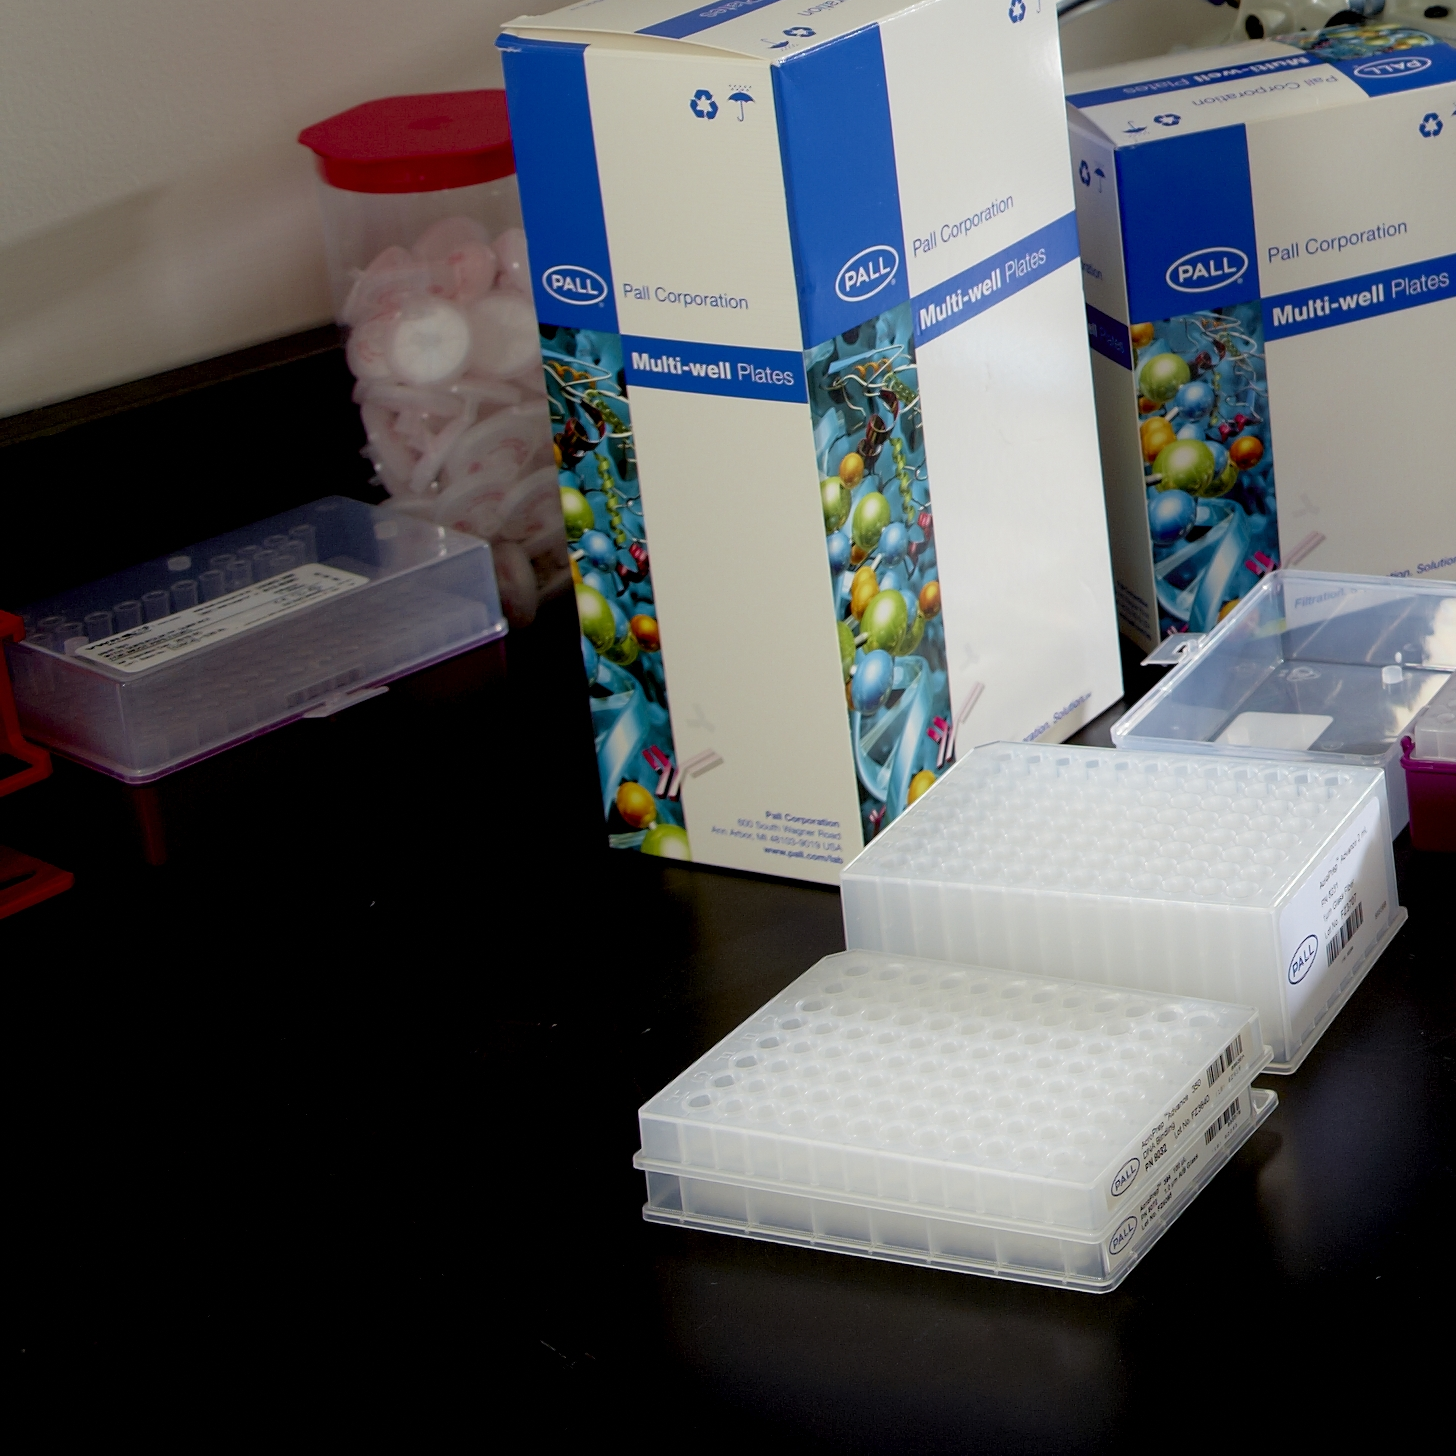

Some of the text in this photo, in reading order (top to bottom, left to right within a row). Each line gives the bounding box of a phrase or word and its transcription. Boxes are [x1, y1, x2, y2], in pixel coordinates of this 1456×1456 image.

[1122, 55, 1310, 95] Multi-well Plates
[1363, 59, 1421, 75] PALL
[1191, 74, 1339, 108] Pall Corporation
[912, 195, 1014, 258] Pall Corporation
[1267, 220, 1408, 263] Pall Corporation
[844, 256, 891, 292] PALL
[1178, 256, 1238, 282] PALL
[551, 274, 599, 295] PALL
[622, 283, 750, 309] Pall Corporation
[919, 247, 1047, 331] Multi-well Plates
[1272, 270, 1450, 327] Multi-well Plates
[631, 351, 795, 386] Multi-well Plates
[765, 810, 840, 828] Pall Corporation
[818, 829, 841, 840] Road
[763, 847, 843, 864] www.pall.com/lab
[1292, 944, 1315, 978] PALL
[1115, 1164, 1137, 1191] PALL
[1144, 1159, 1154, 1172] PN
[1112, 1223, 1134, 1249] PALL
